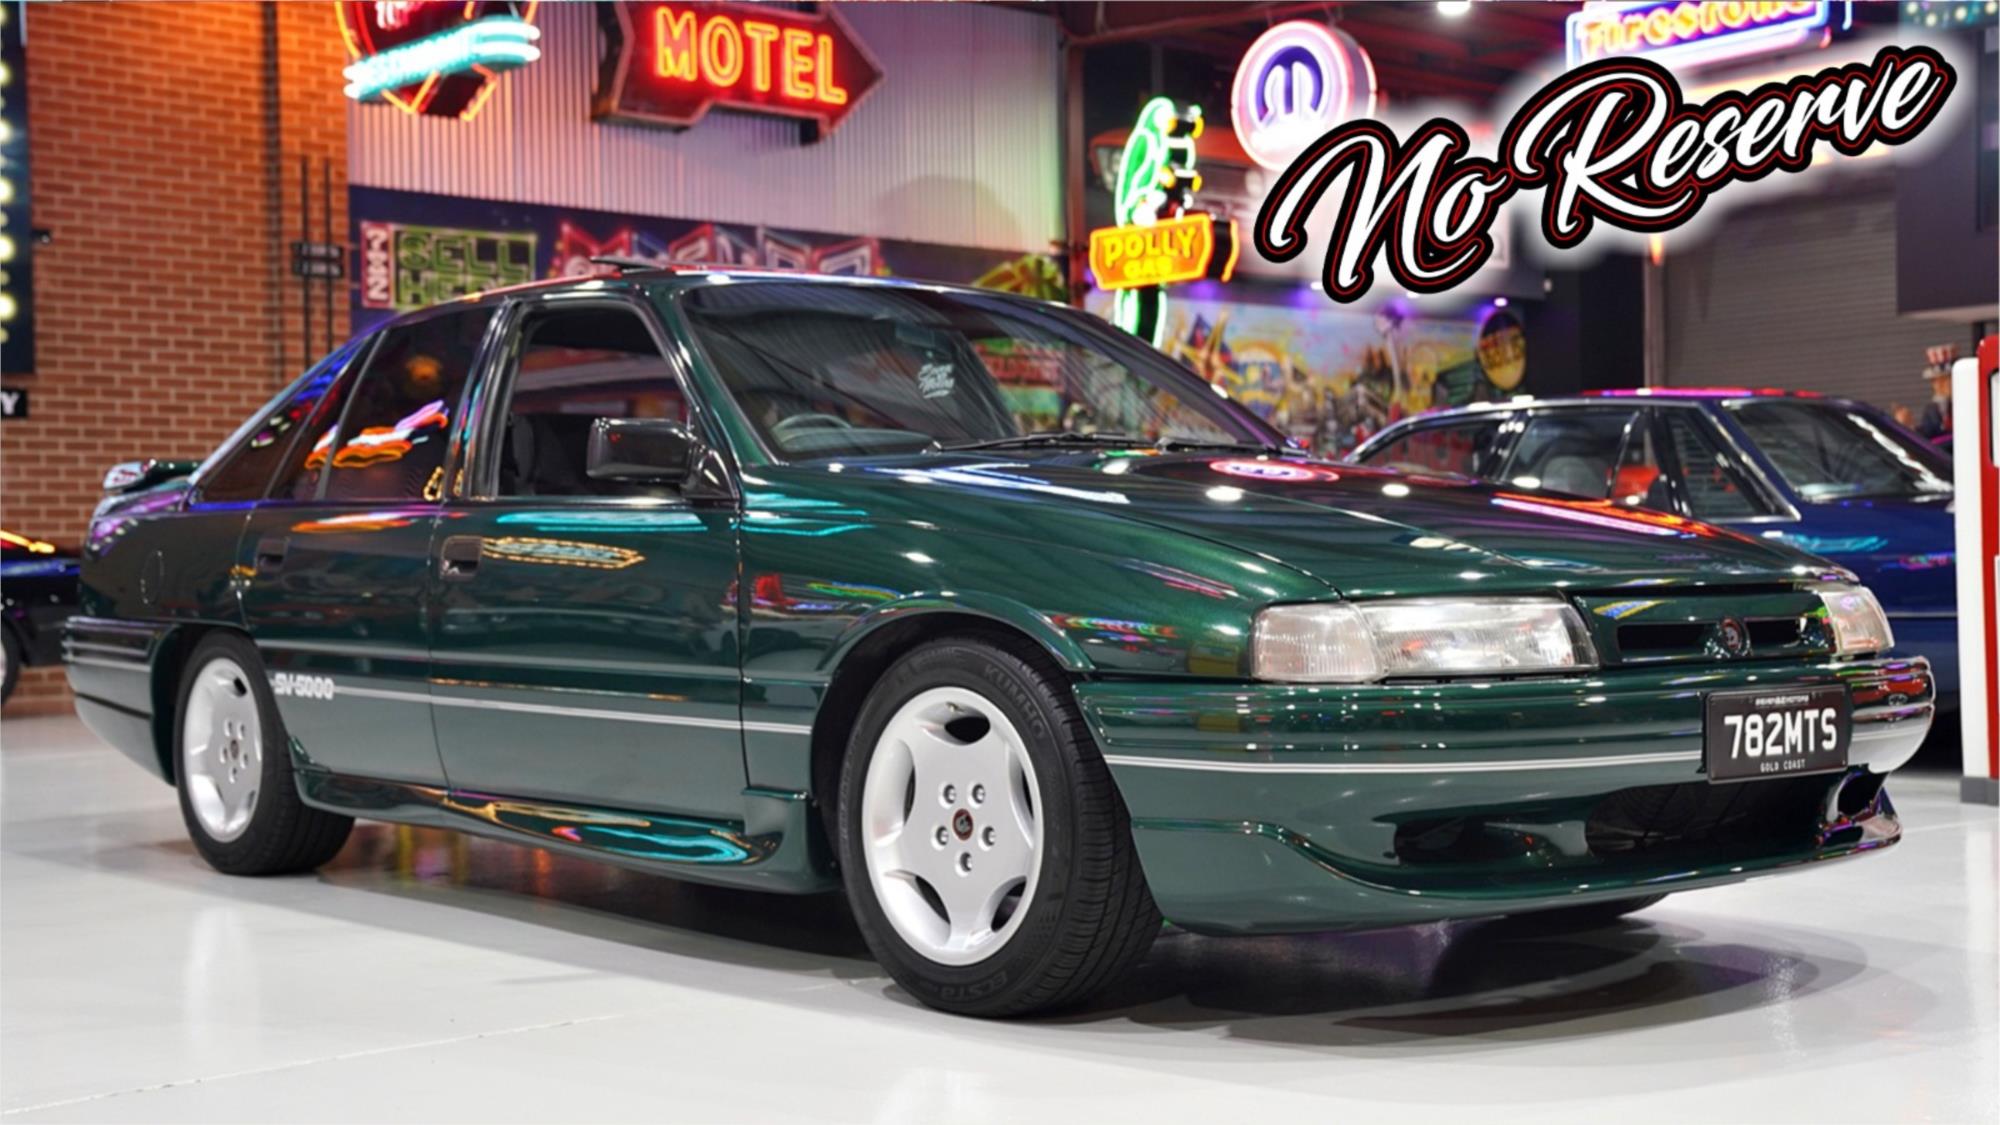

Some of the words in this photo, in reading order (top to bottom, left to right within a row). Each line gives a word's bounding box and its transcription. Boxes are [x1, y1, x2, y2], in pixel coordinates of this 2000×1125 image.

[655, 6, 848, 105] MOTEL
[400, 230, 528, 280] SELL
[1103, 227, 1196, 268] POLLY
[984, 663, 1045, 739] KUMHO
[1723, 707, 1838, 760] 782MTS
[1760, 761, 1780, 773] GOLD
[1783, 758, 1806, 771] COAST
